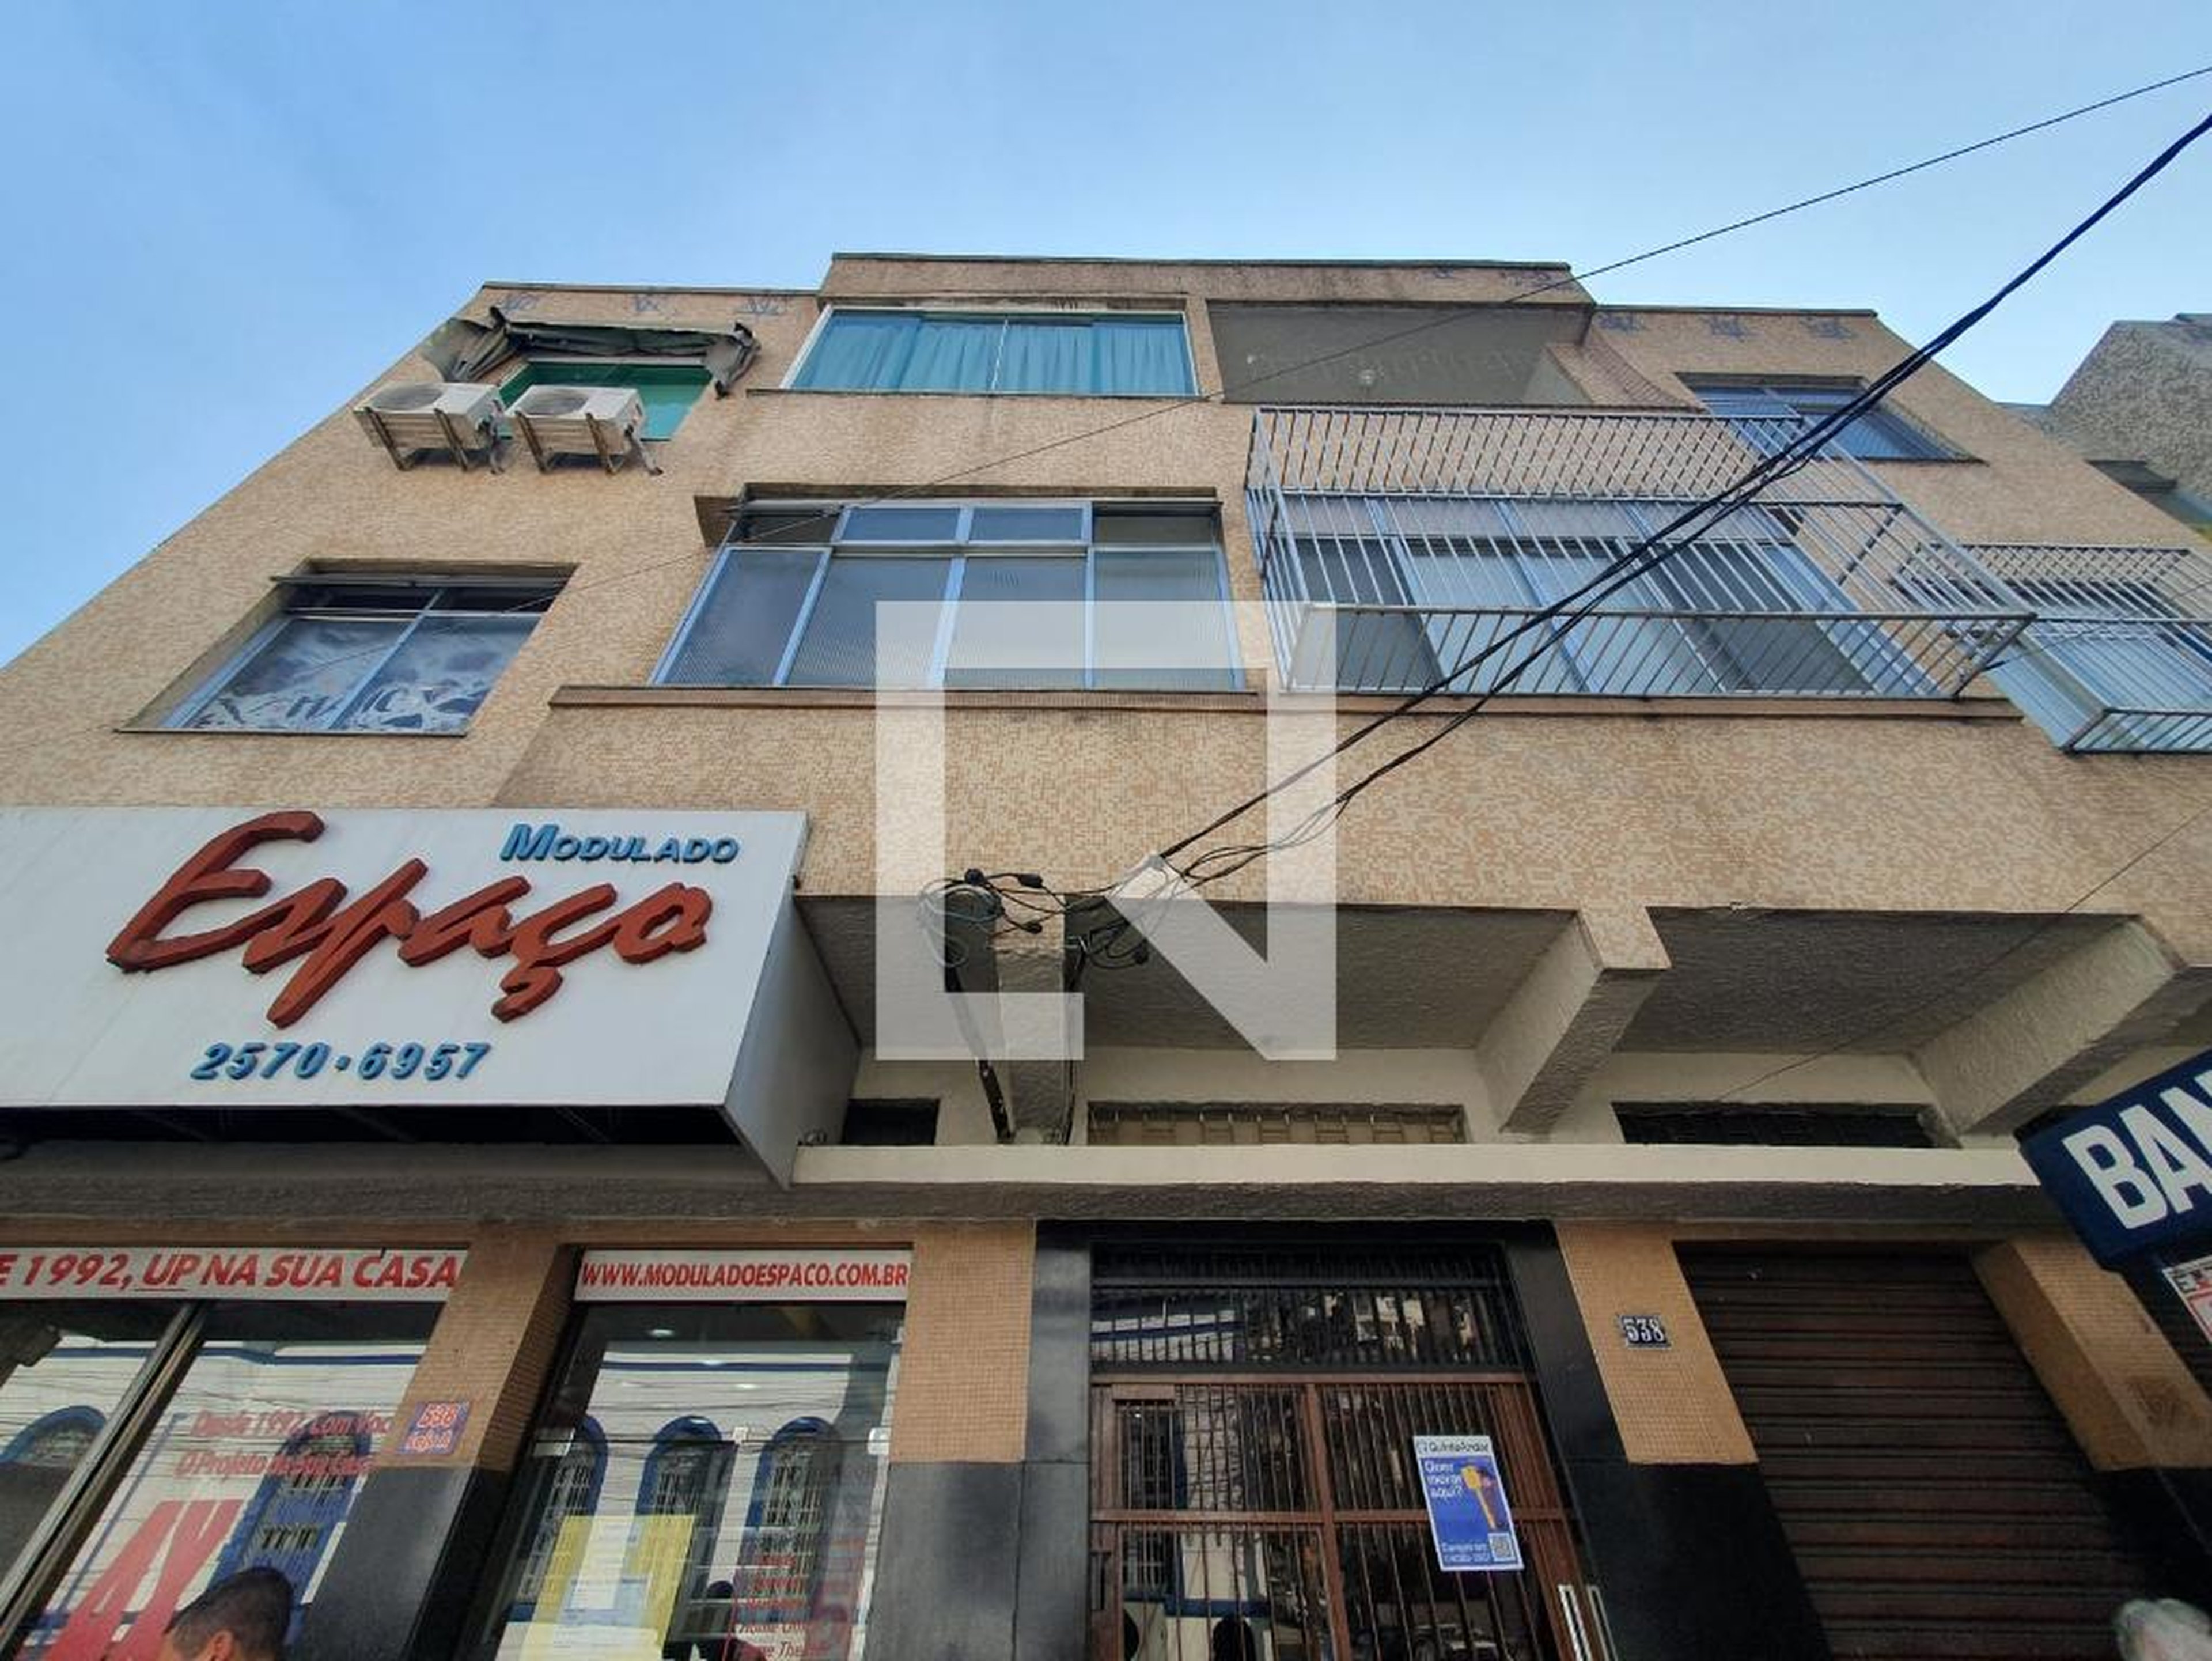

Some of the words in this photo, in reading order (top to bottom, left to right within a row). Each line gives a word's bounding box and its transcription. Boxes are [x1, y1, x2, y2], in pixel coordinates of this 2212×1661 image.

[499, 823, 740, 864] MODULADO
[106, 809, 713, 1030] Espaço
[23, 1253, 133, 1290] 1992,
[142, 1254, 201, 1286] UP
[200, 1254, 256, 1287] NA
[264, 1255, 344, 1287] SUA
[353, 1255, 460, 1288] CASA
[581, 1263, 908, 1288] WWW.MODULADOESPACO.COM.BR
[1623, 1318, 1664, 1342] 538
